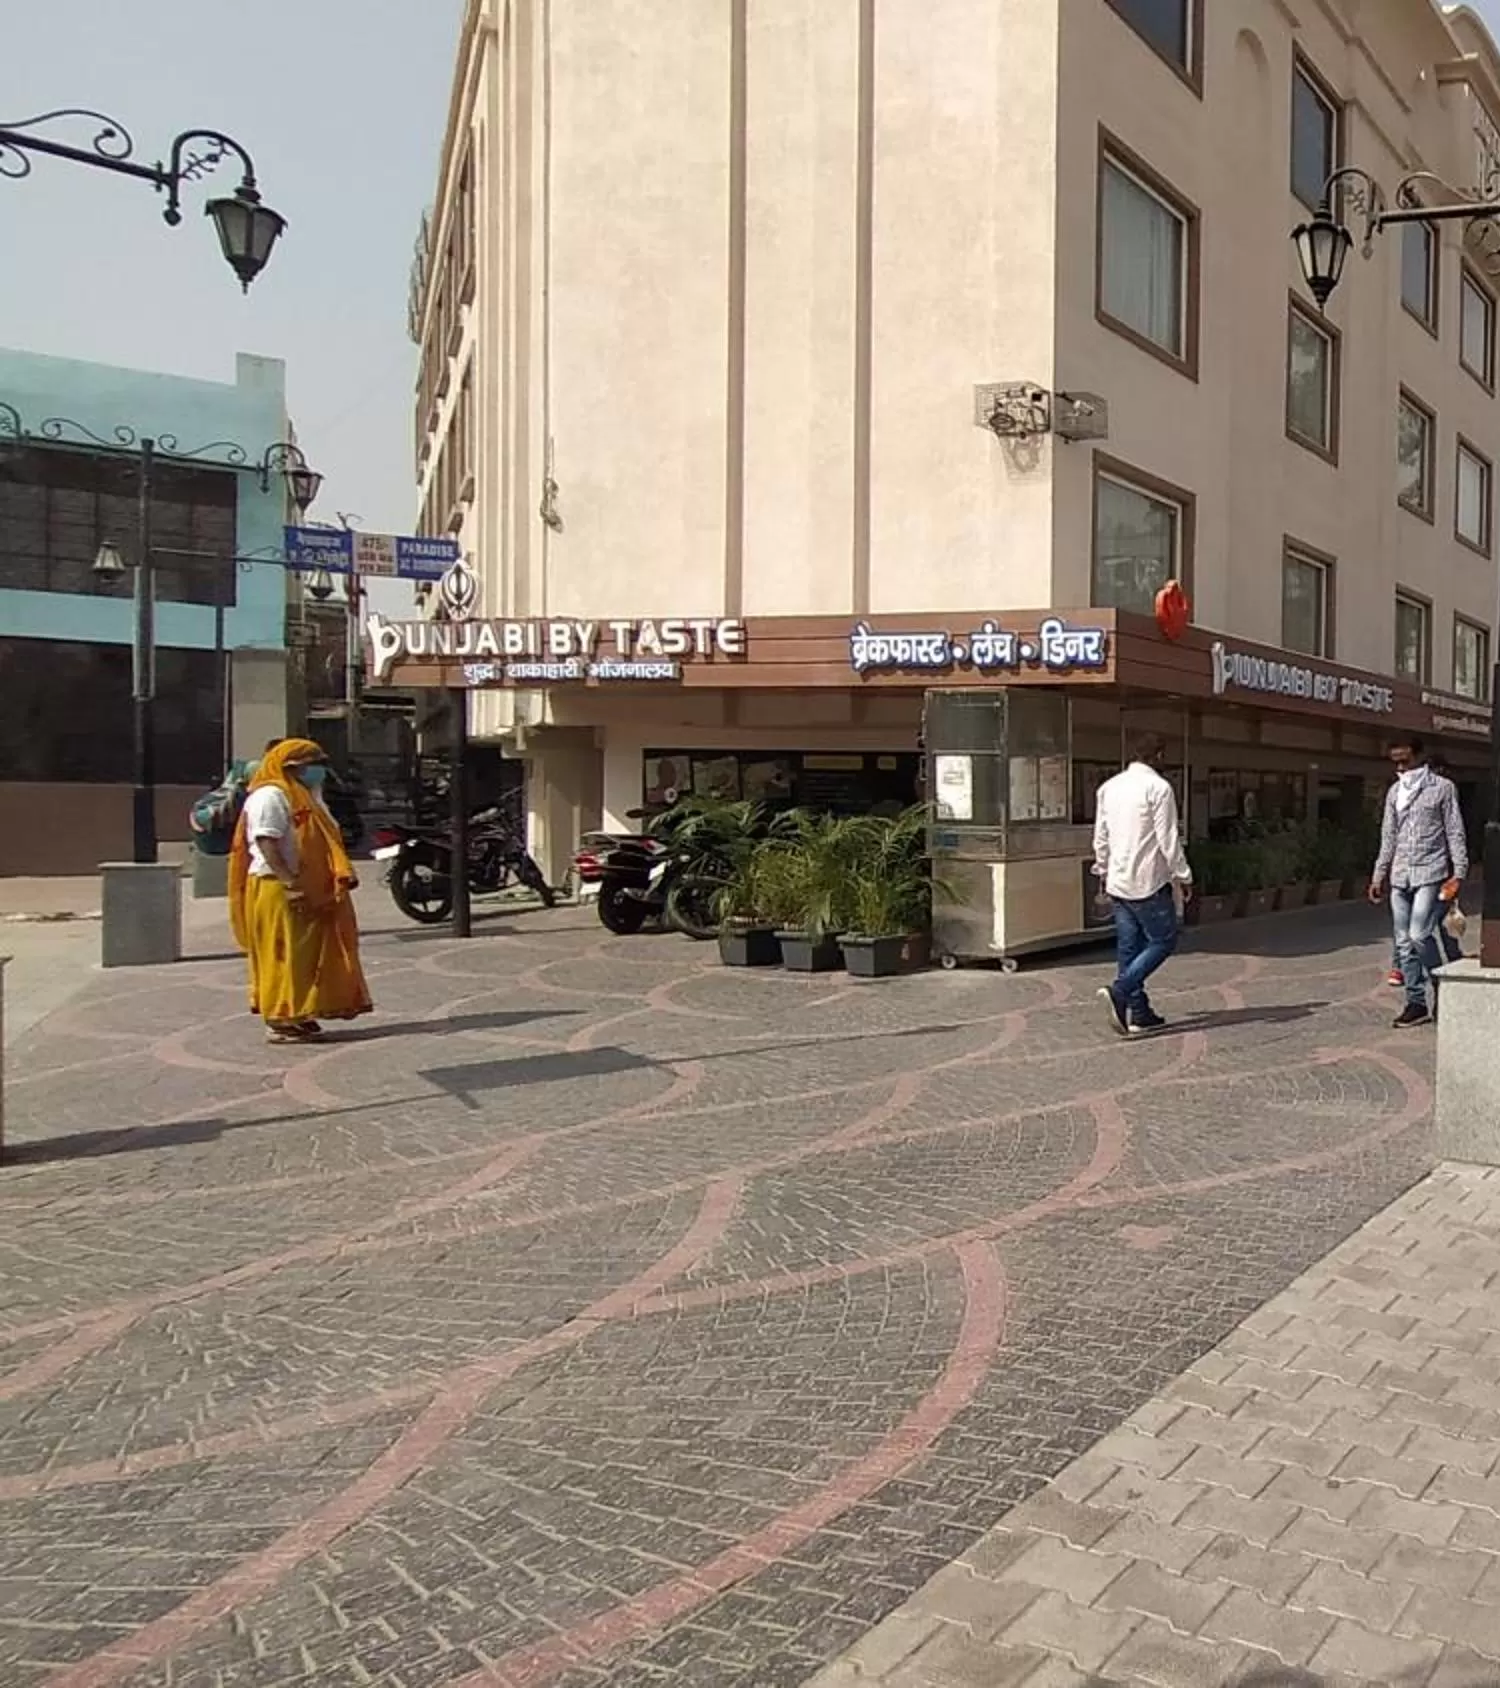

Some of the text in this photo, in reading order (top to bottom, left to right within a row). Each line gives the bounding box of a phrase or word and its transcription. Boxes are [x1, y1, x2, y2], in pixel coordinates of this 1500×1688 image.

[367, 614, 740, 677] PUNJABI BY TASTE
[851, 619, 1103, 668] ब्रेकफास्ट लंच डिनर
[1212, 641, 1313, 698] PUNJABI
[1313, 674, 1338, 702] BY
[1340, 677, 1393, 713] TASTE
